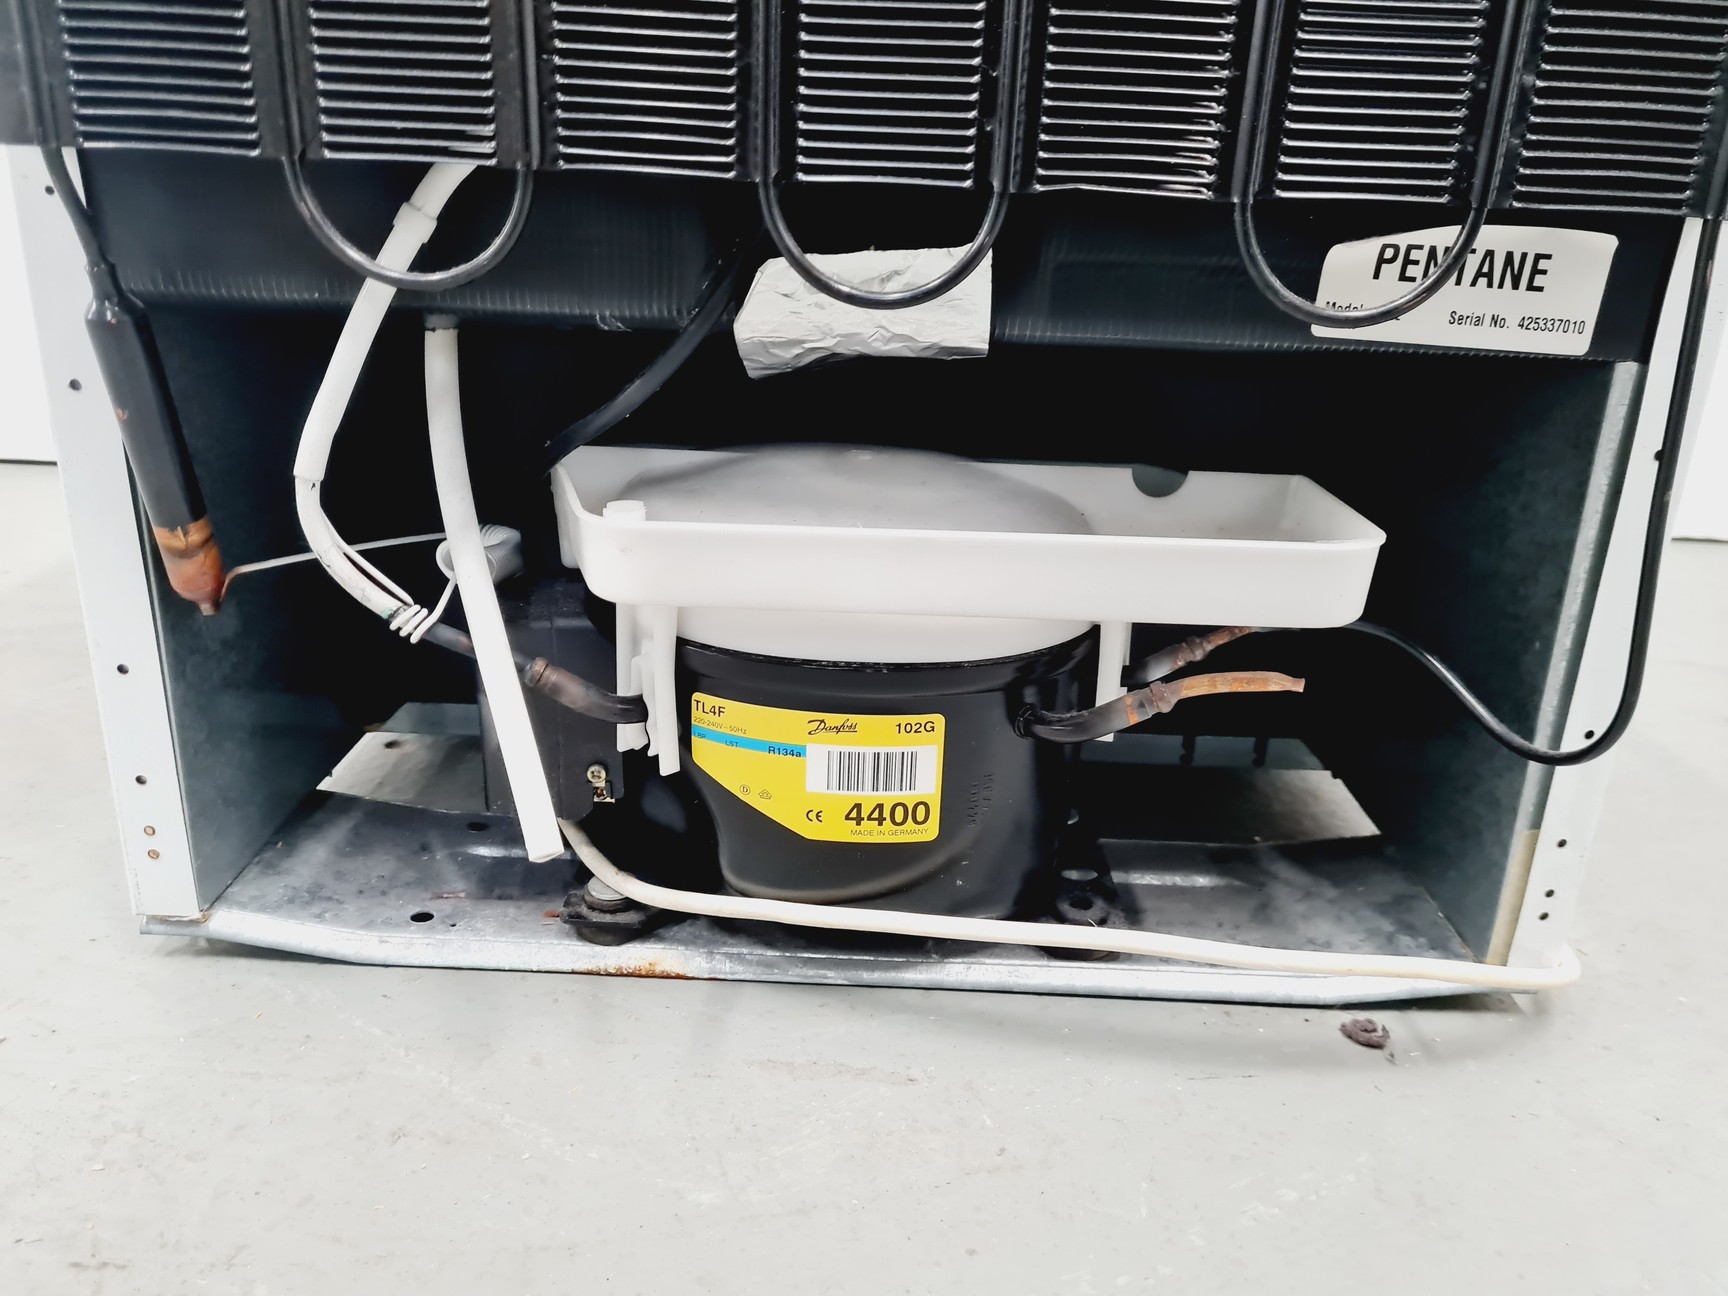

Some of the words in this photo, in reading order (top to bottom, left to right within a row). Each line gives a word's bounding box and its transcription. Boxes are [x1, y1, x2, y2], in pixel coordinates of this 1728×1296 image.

[1372, 243, 1553, 293] PENTANE
[1448, 310, 1486, 328] Serial
[1489, 314, 1510, 329] No.
[1517, 316, 1586, 335] 425337010
[694, 699, 726, 718] TL4F
[806, 718, 858, 736] Danfoss
[895, 720, 936, 735] 102G
[768, 745, 802, 758] R134a
[844, 800, 931, 827] 4400
[850, 828, 875, 837] MADE
[876, 829, 886, 837] IN
[887, 828, 929, 836] GERMANY
